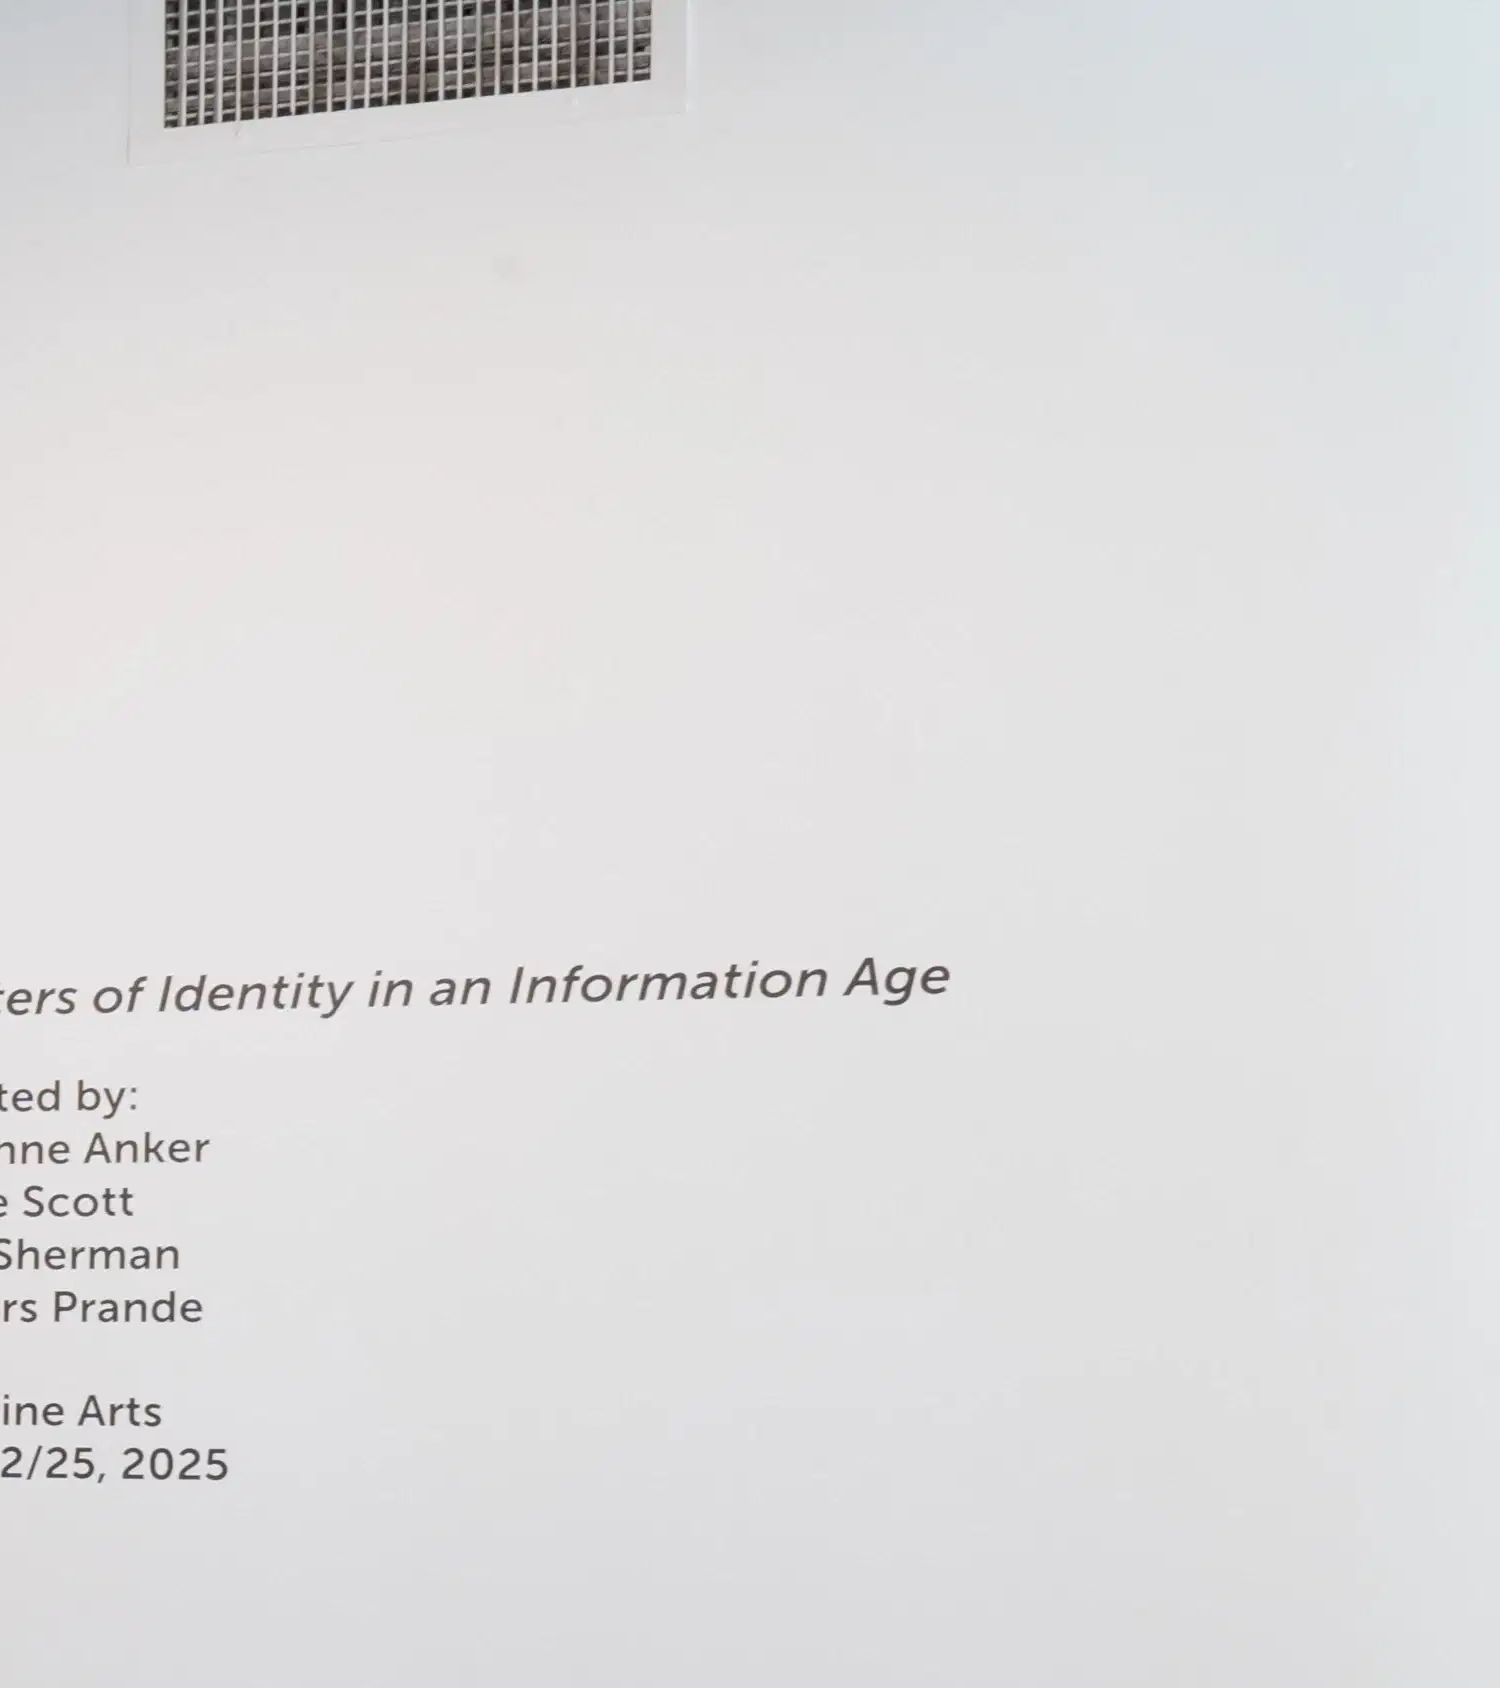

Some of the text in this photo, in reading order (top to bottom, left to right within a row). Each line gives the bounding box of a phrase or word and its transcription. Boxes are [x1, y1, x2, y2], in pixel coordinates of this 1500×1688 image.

[92, 975, 149, 1014] of
[158, 971, 355, 1020] Identity
[367, 969, 414, 1008] in
[429, 977, 492, 1007] an
[509, 959, 829, 1005] Information
[842, 956, 951, 1007] Age
[76, 1079, 137, 1120] by:
[83, 1131, 211, 1165] Anker
[22, 1184, 134, 1218] Scott
[53, 1290, 204, 1324] Prande
[77, 1394, 162, 1428] Arts
[0, 1444, 106, 1484] 2/25,
[121, 1447, 229, 1481] 2025
